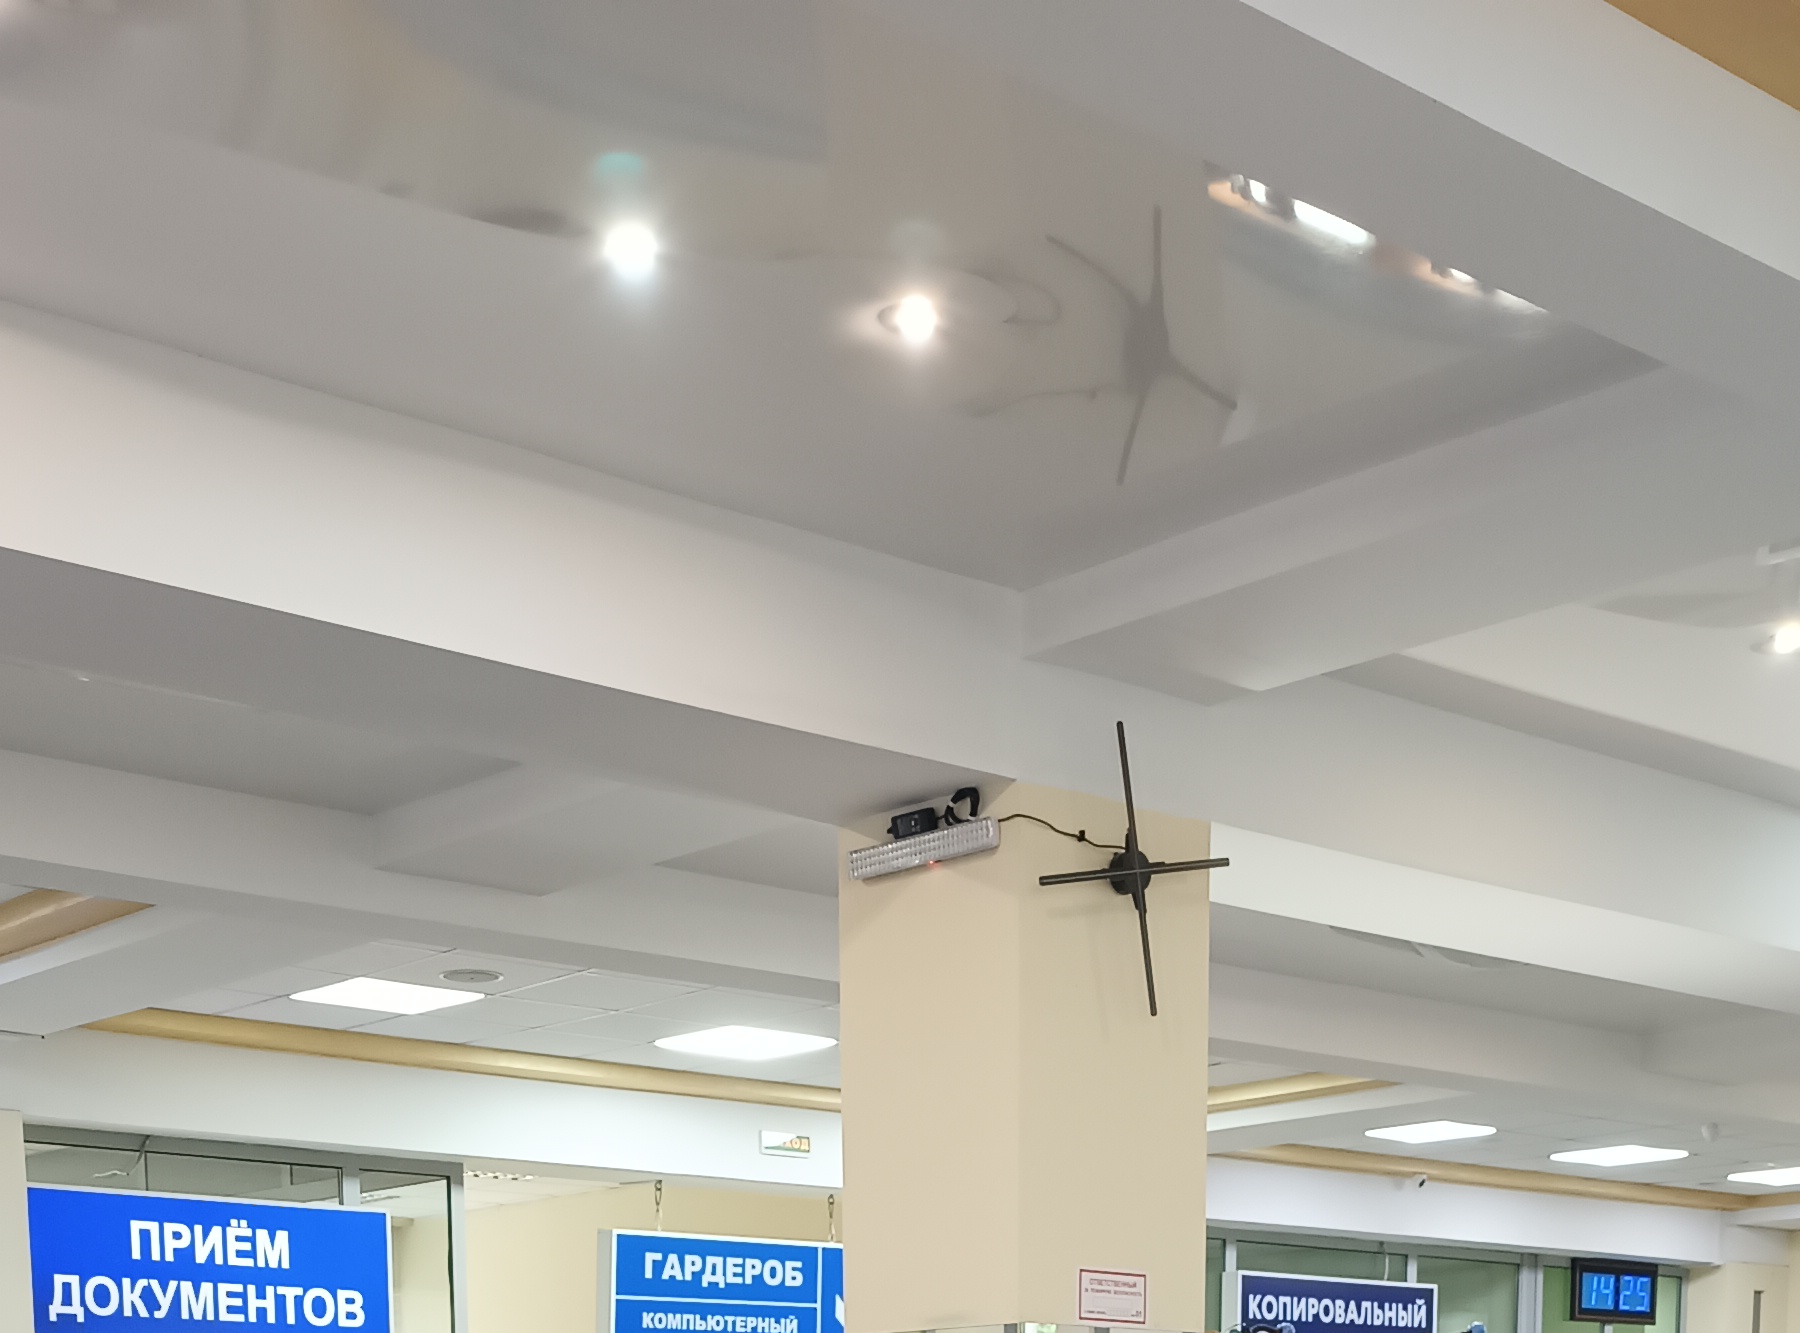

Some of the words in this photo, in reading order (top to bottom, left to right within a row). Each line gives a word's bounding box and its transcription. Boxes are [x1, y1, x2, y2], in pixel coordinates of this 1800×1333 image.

[129, 1218, 291, 1270] ПРИЁМ
[644, 1252, 804, 1288] ГАРДЕРОБ
[48, 1273, 366, 1329] ДОКУМЕНТОВ
[1248, 1294, 1427, 1329] КОПИРОВАЛЬНЫЙ
